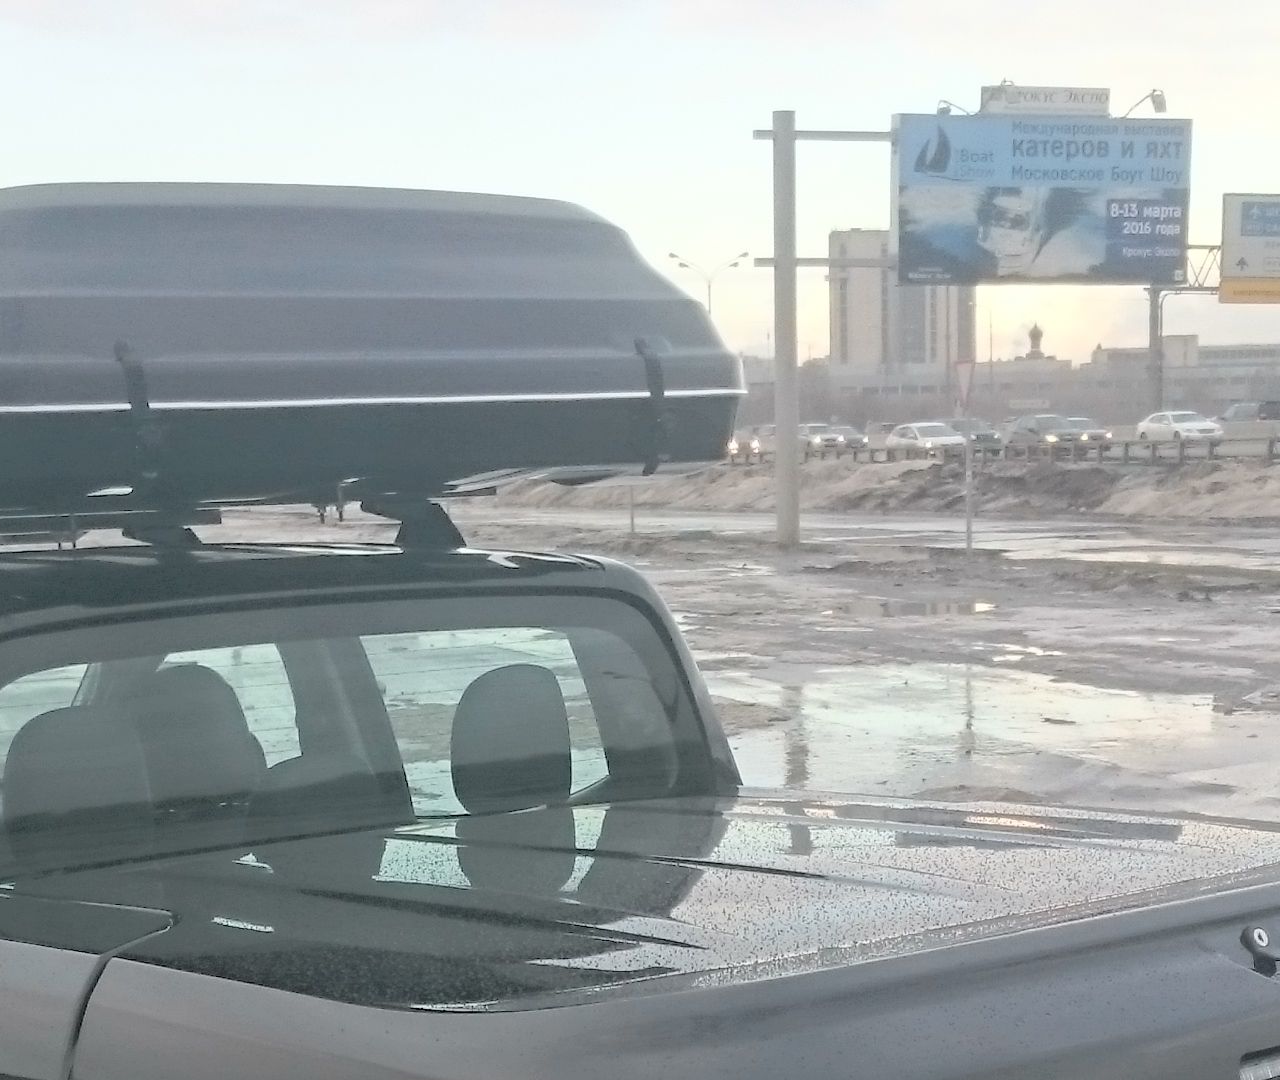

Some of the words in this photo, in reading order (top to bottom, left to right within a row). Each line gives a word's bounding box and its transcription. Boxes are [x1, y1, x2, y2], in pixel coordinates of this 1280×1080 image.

[1011, 120, 1119, 137] Международная
[1123, 124, 1185, 136] выставка
[960, 149, 994, 163] Boat
[1011, 138, 1110, 161] катеров
[1121, 141, 1135, 159] и
[1144, 141, 1184, 159] яхт
[1011, 165, 1105, 181] Московское
[1111, 165, 1145, 184] Боут
[1150, 166, 1183, 184] Шоу
[1110, 203, 1139, 218] 8-13
[1143, 206, 1182, 221] марта
[1123, 221, 1152, 235] 2016
[1155, 224, 1181, 237] года
